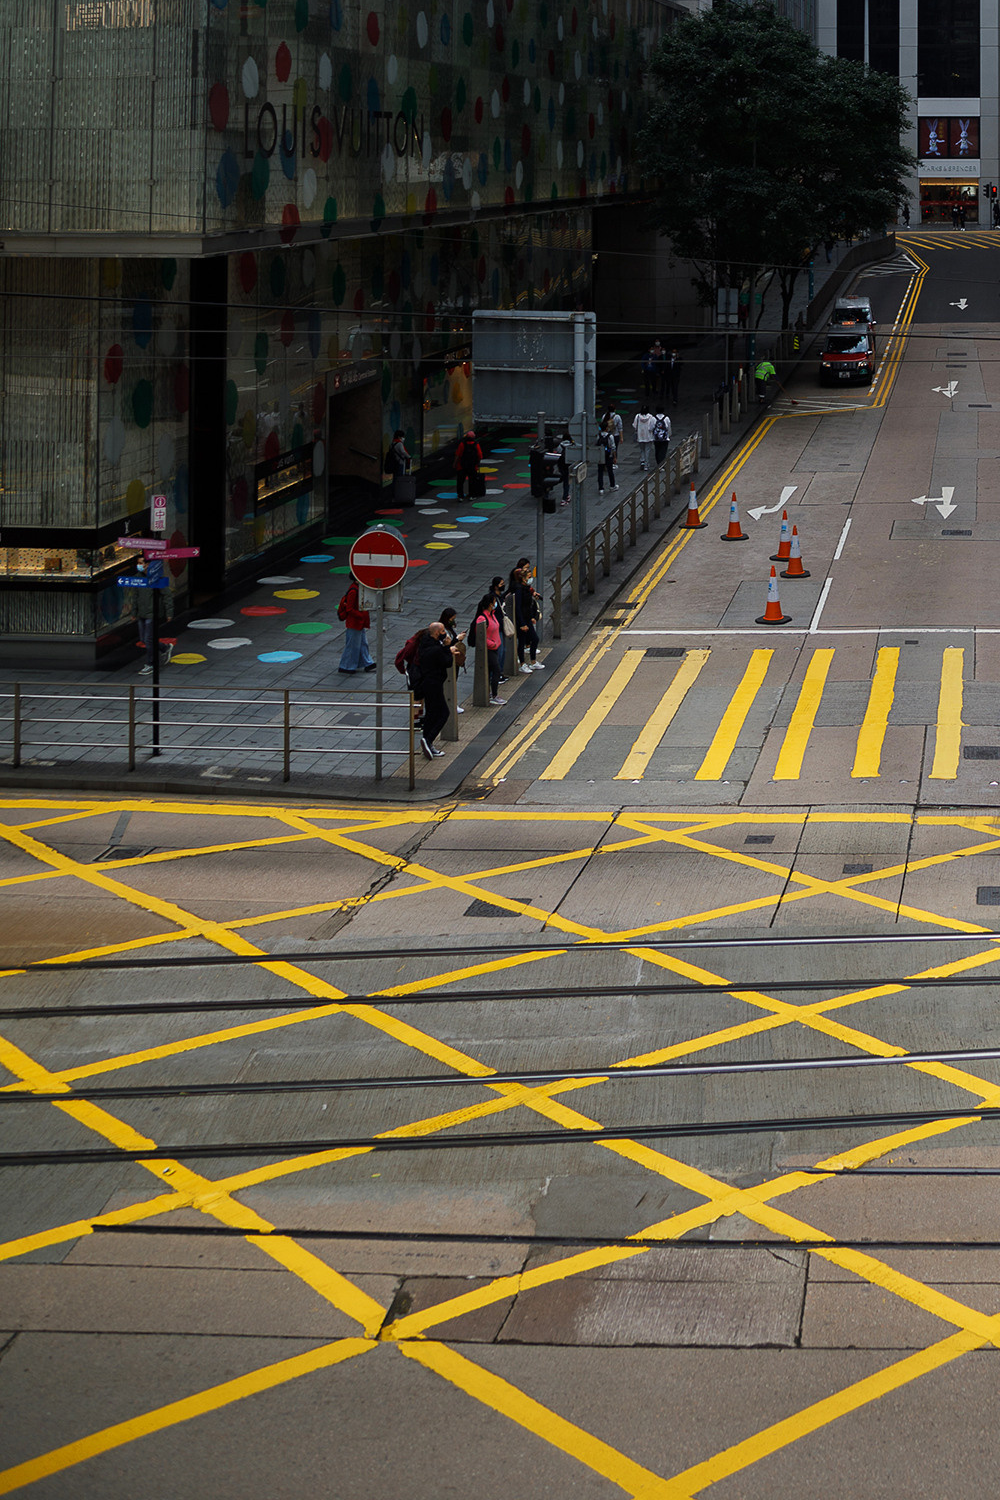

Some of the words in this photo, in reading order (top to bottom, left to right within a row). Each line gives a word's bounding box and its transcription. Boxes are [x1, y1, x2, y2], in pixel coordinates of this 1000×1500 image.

[244, 101, 322, 159] LOUIS
[333, 105, 425, 159] VUITTON
[155, 510, 165, 529] 中環
